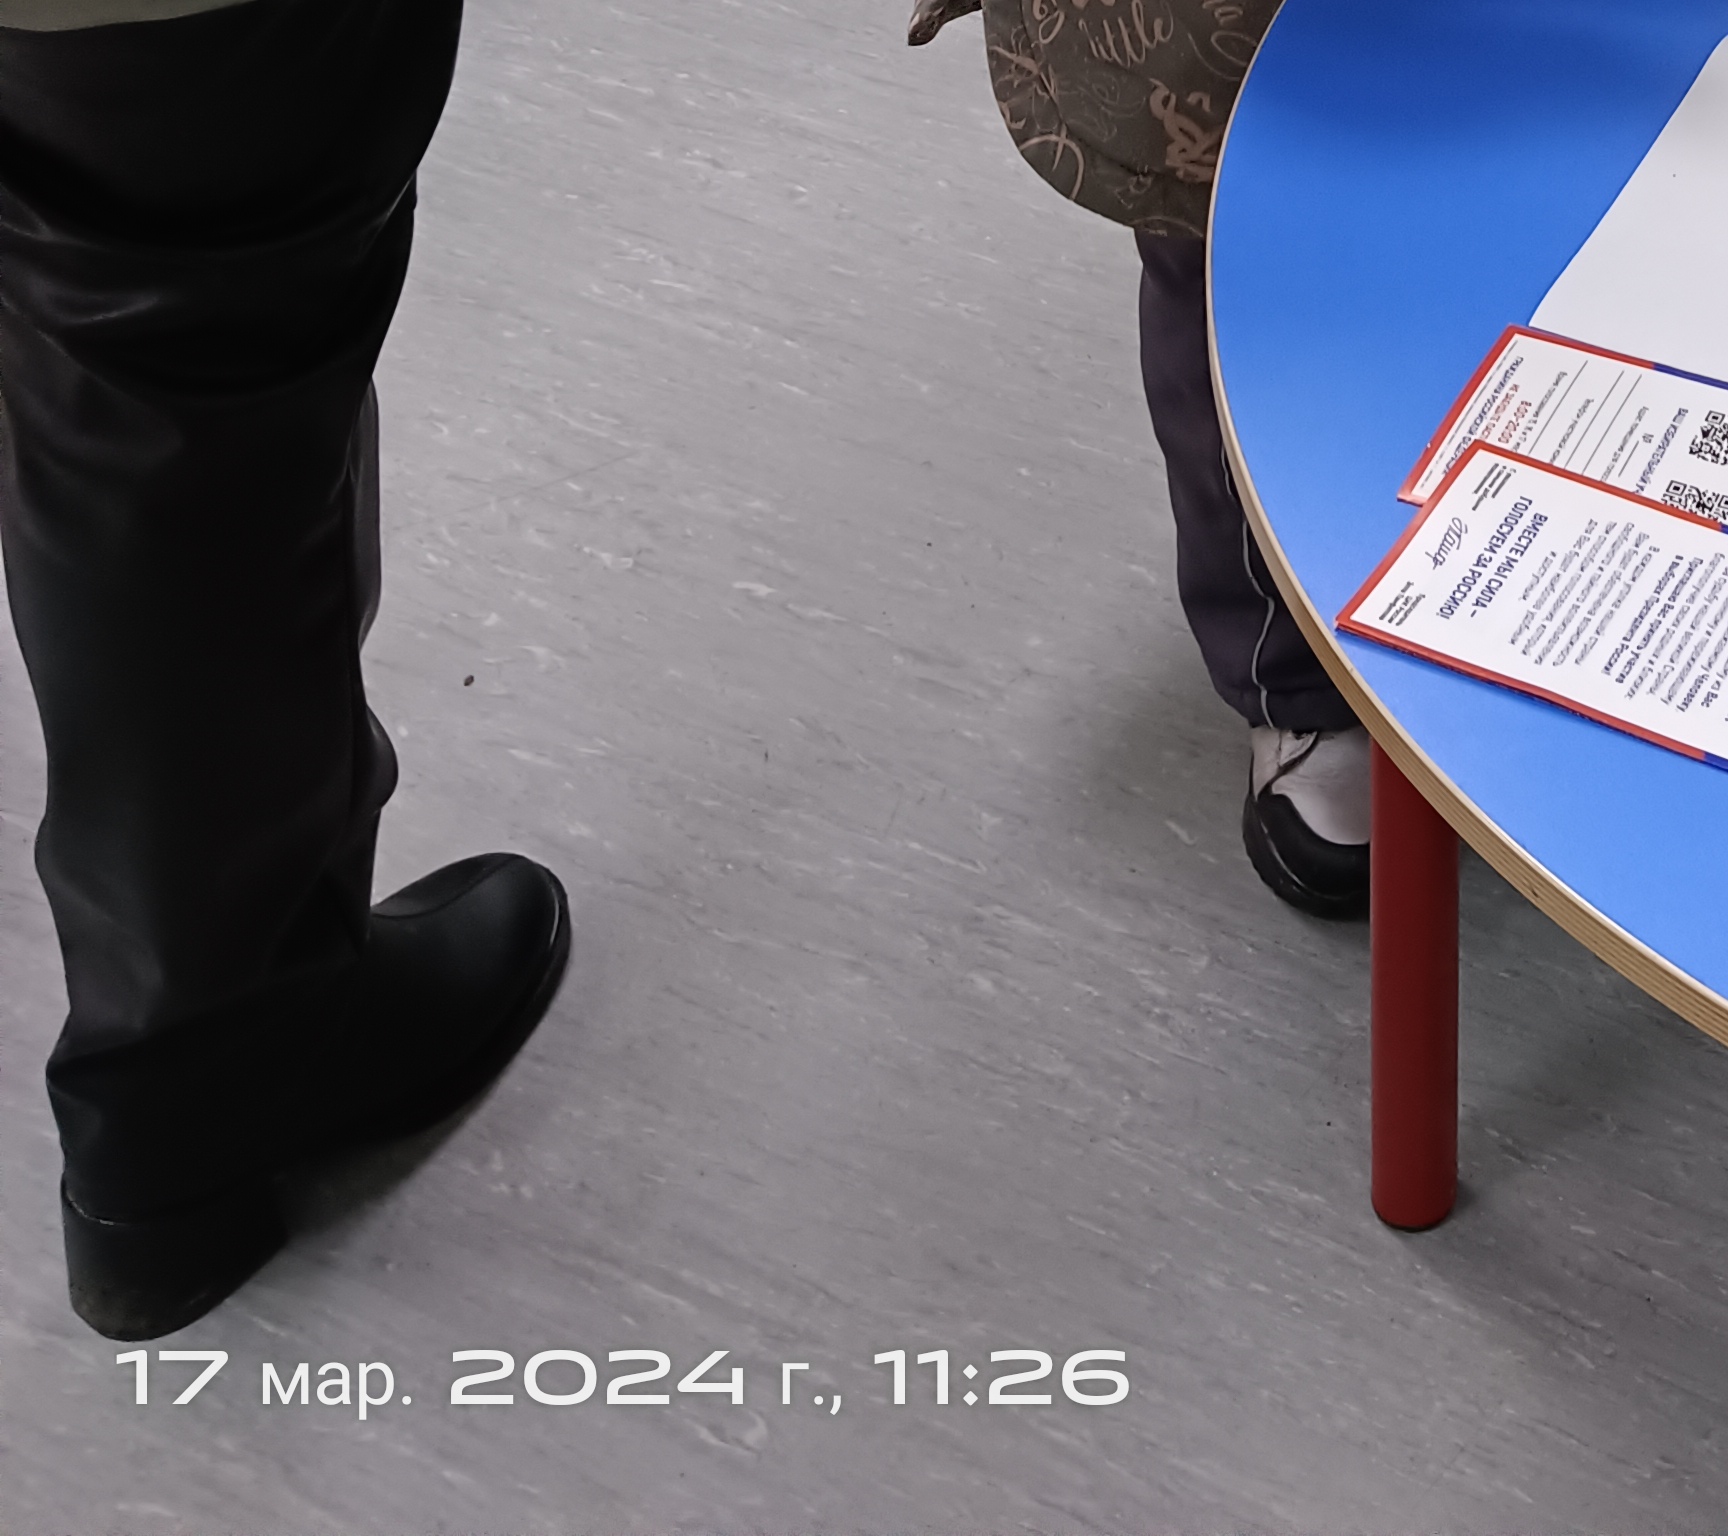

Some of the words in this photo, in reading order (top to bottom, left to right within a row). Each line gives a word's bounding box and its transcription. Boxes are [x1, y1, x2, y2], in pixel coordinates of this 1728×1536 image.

[1483, 495, 1532, 554] ГОЛОСУЕМ
[1508, 512, 1548, 557] ВМЕСТЕ
[1471, 552, 1493, 568] ЗА
[1493, 555, 1518, 579] МЫ
[1436, 568, 1482, 619] РОССИЮ!
[1471, 577, 1503, 608] СИЛА
